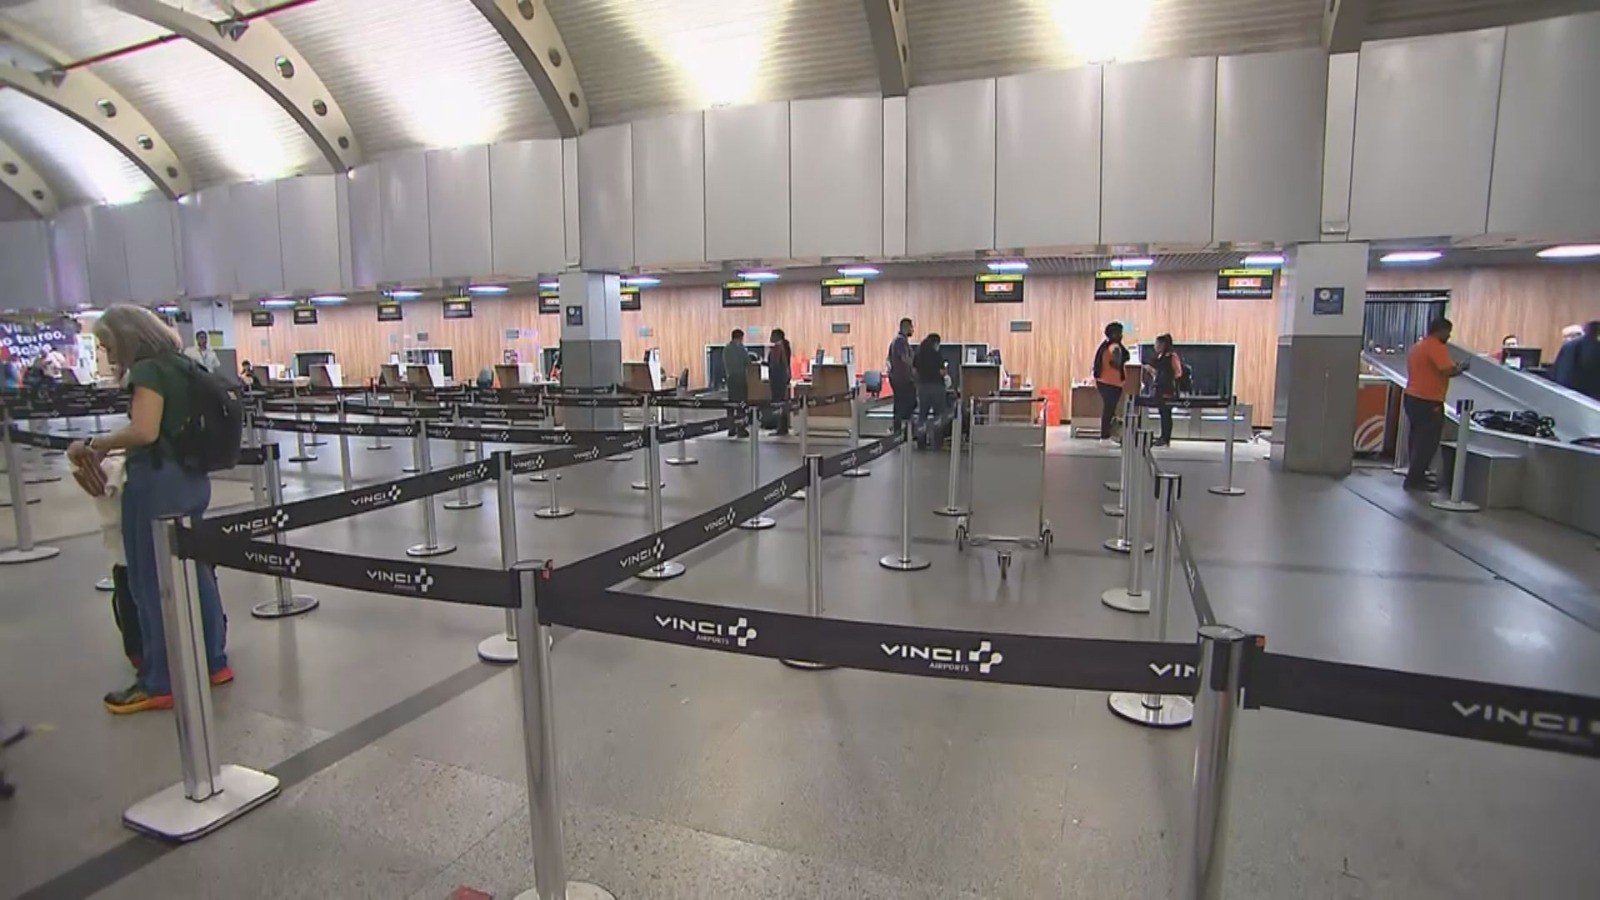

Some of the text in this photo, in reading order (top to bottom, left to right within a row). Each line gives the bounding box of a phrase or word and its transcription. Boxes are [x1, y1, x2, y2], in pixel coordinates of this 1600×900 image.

[448, 470, 476, 482] VINCI
[351, 492, 386, 506] VINCI
[222, 517, 269, 534] VINCI
[704, 516, 727, 532] VINCI
[245, 551, 283, 565] VINCI
[619, 548, 652, 568] VINCI
[366, 569, 411, 584] VINCI
[655, 614, 722, 636] VINCI
[696, 634, 730, 645] AIRPORTS
[880, 643, 961, 662] VINCI
[929, 662, 970, 672] AIRPORTS
[1452, 700, 1579, 733] VINCI
